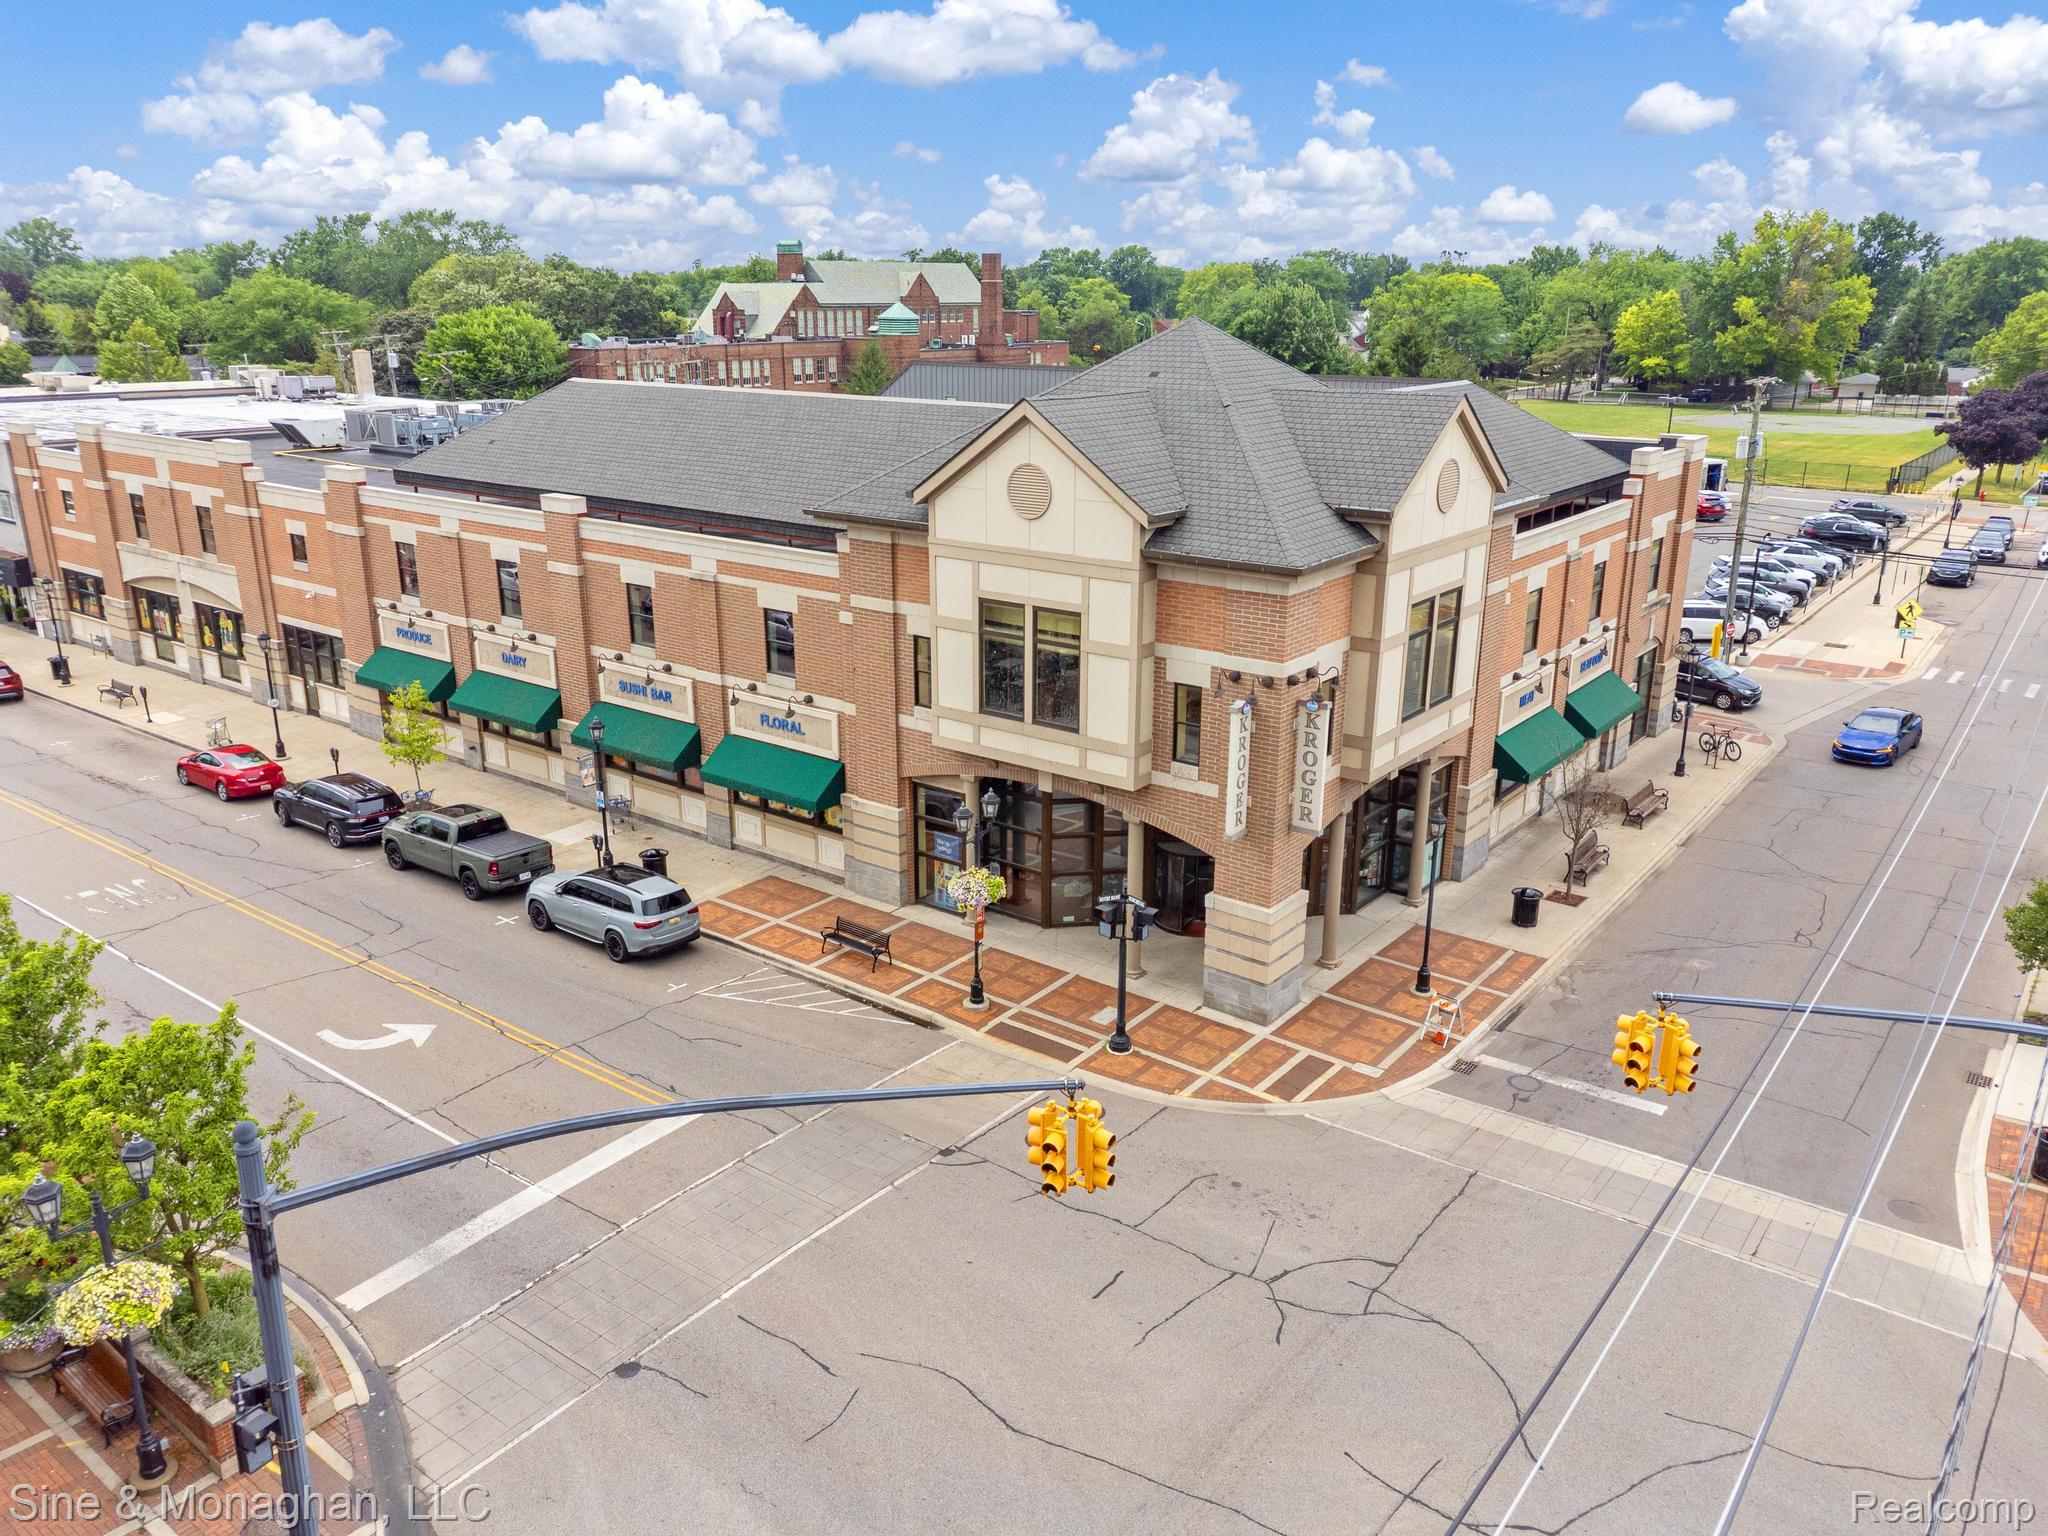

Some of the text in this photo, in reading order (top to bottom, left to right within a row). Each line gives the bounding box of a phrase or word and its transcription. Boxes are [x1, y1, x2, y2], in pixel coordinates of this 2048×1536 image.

[396, 627, 432, 645] PRODUCE
[501, 652, 527, 668] DAIRY
[618, 679, 672, 704] SUSHI BAR
[760, 712, 805, 736] FLORAL
[1234, 715, 1249, 828] KROGER
[1298, 712, 1321, 824] KROGER
